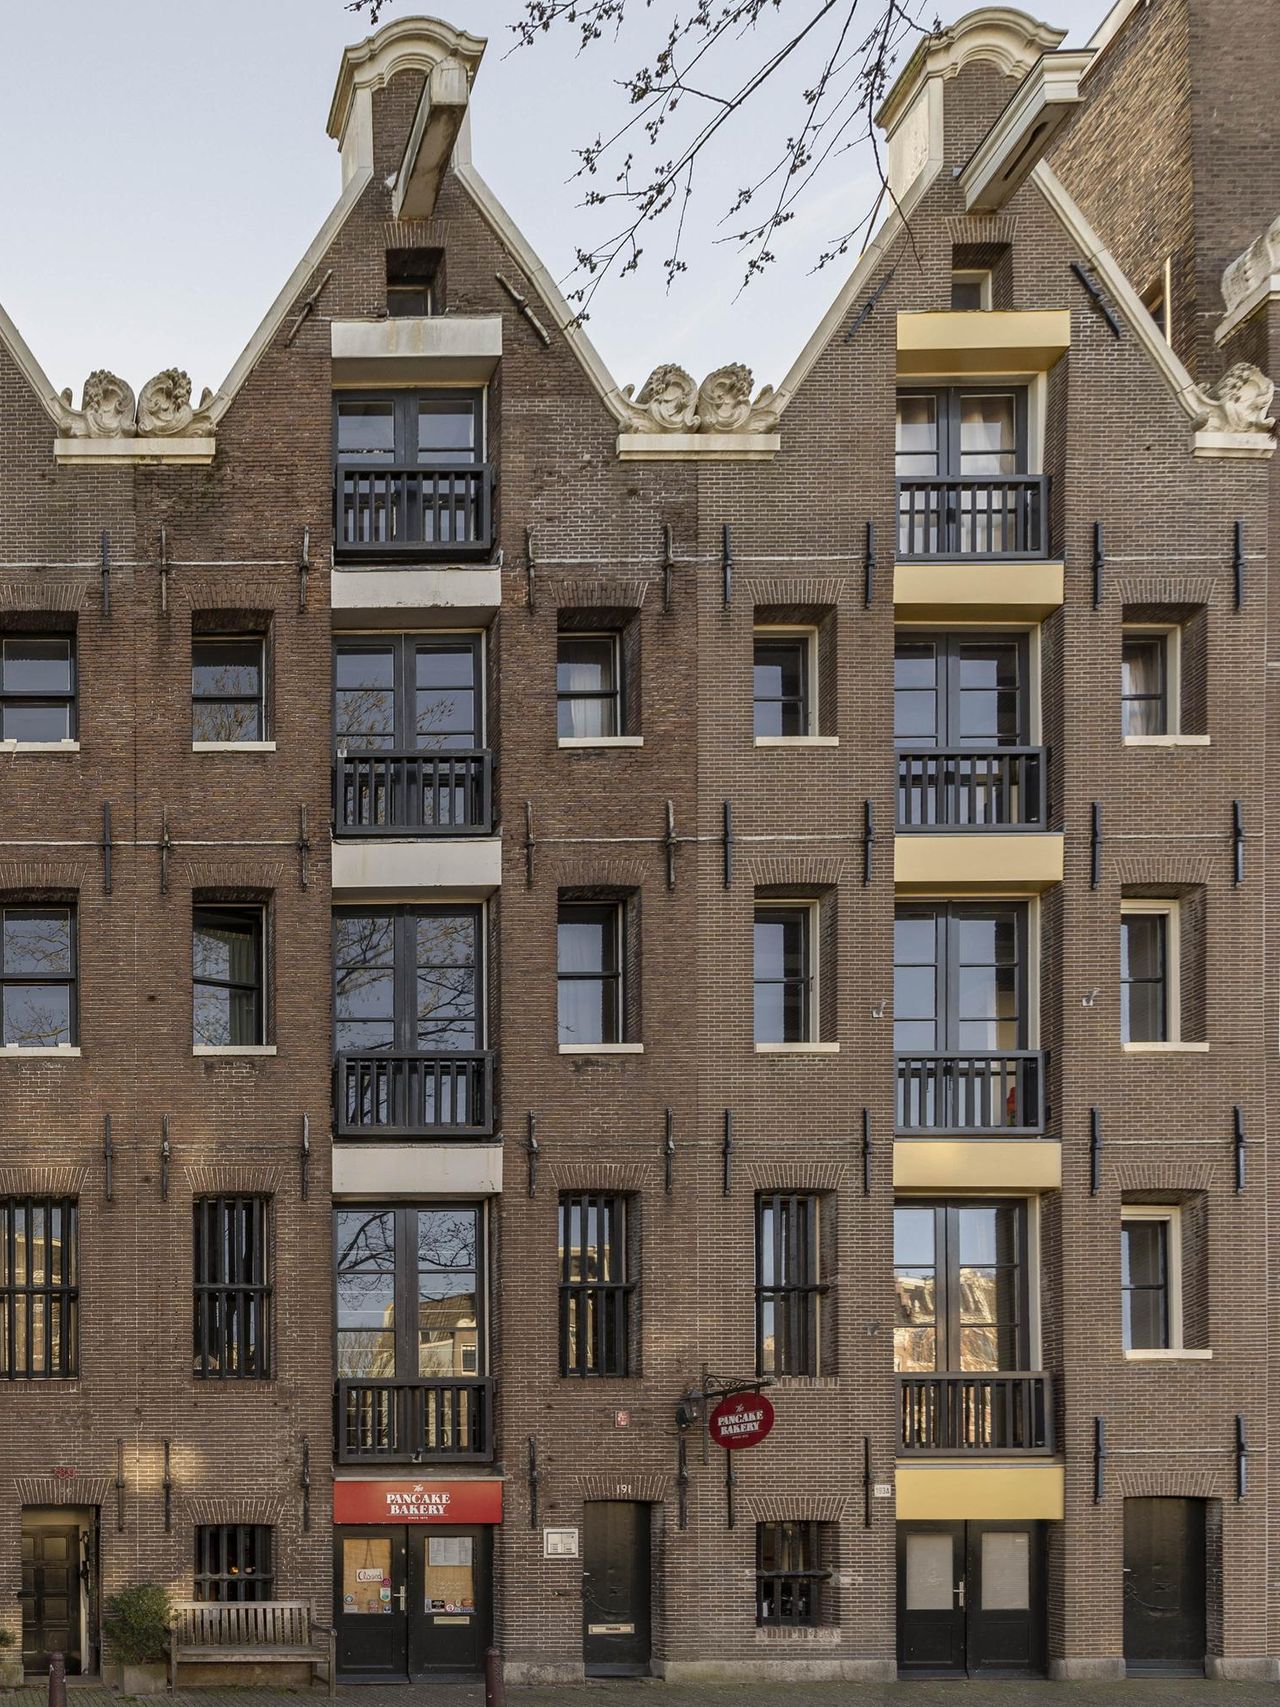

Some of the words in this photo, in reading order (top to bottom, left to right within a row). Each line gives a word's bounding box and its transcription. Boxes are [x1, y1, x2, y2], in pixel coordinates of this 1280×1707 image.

[718, 1411, 763, 1426] PANCAKE
[721, 1422, 759, 1435] BAKERY
[617, 1485, 631, 1494] 191
[386, 1494, 451, 1504] PANCAKE
[391, 1505, 447, 1514] BAKERY
